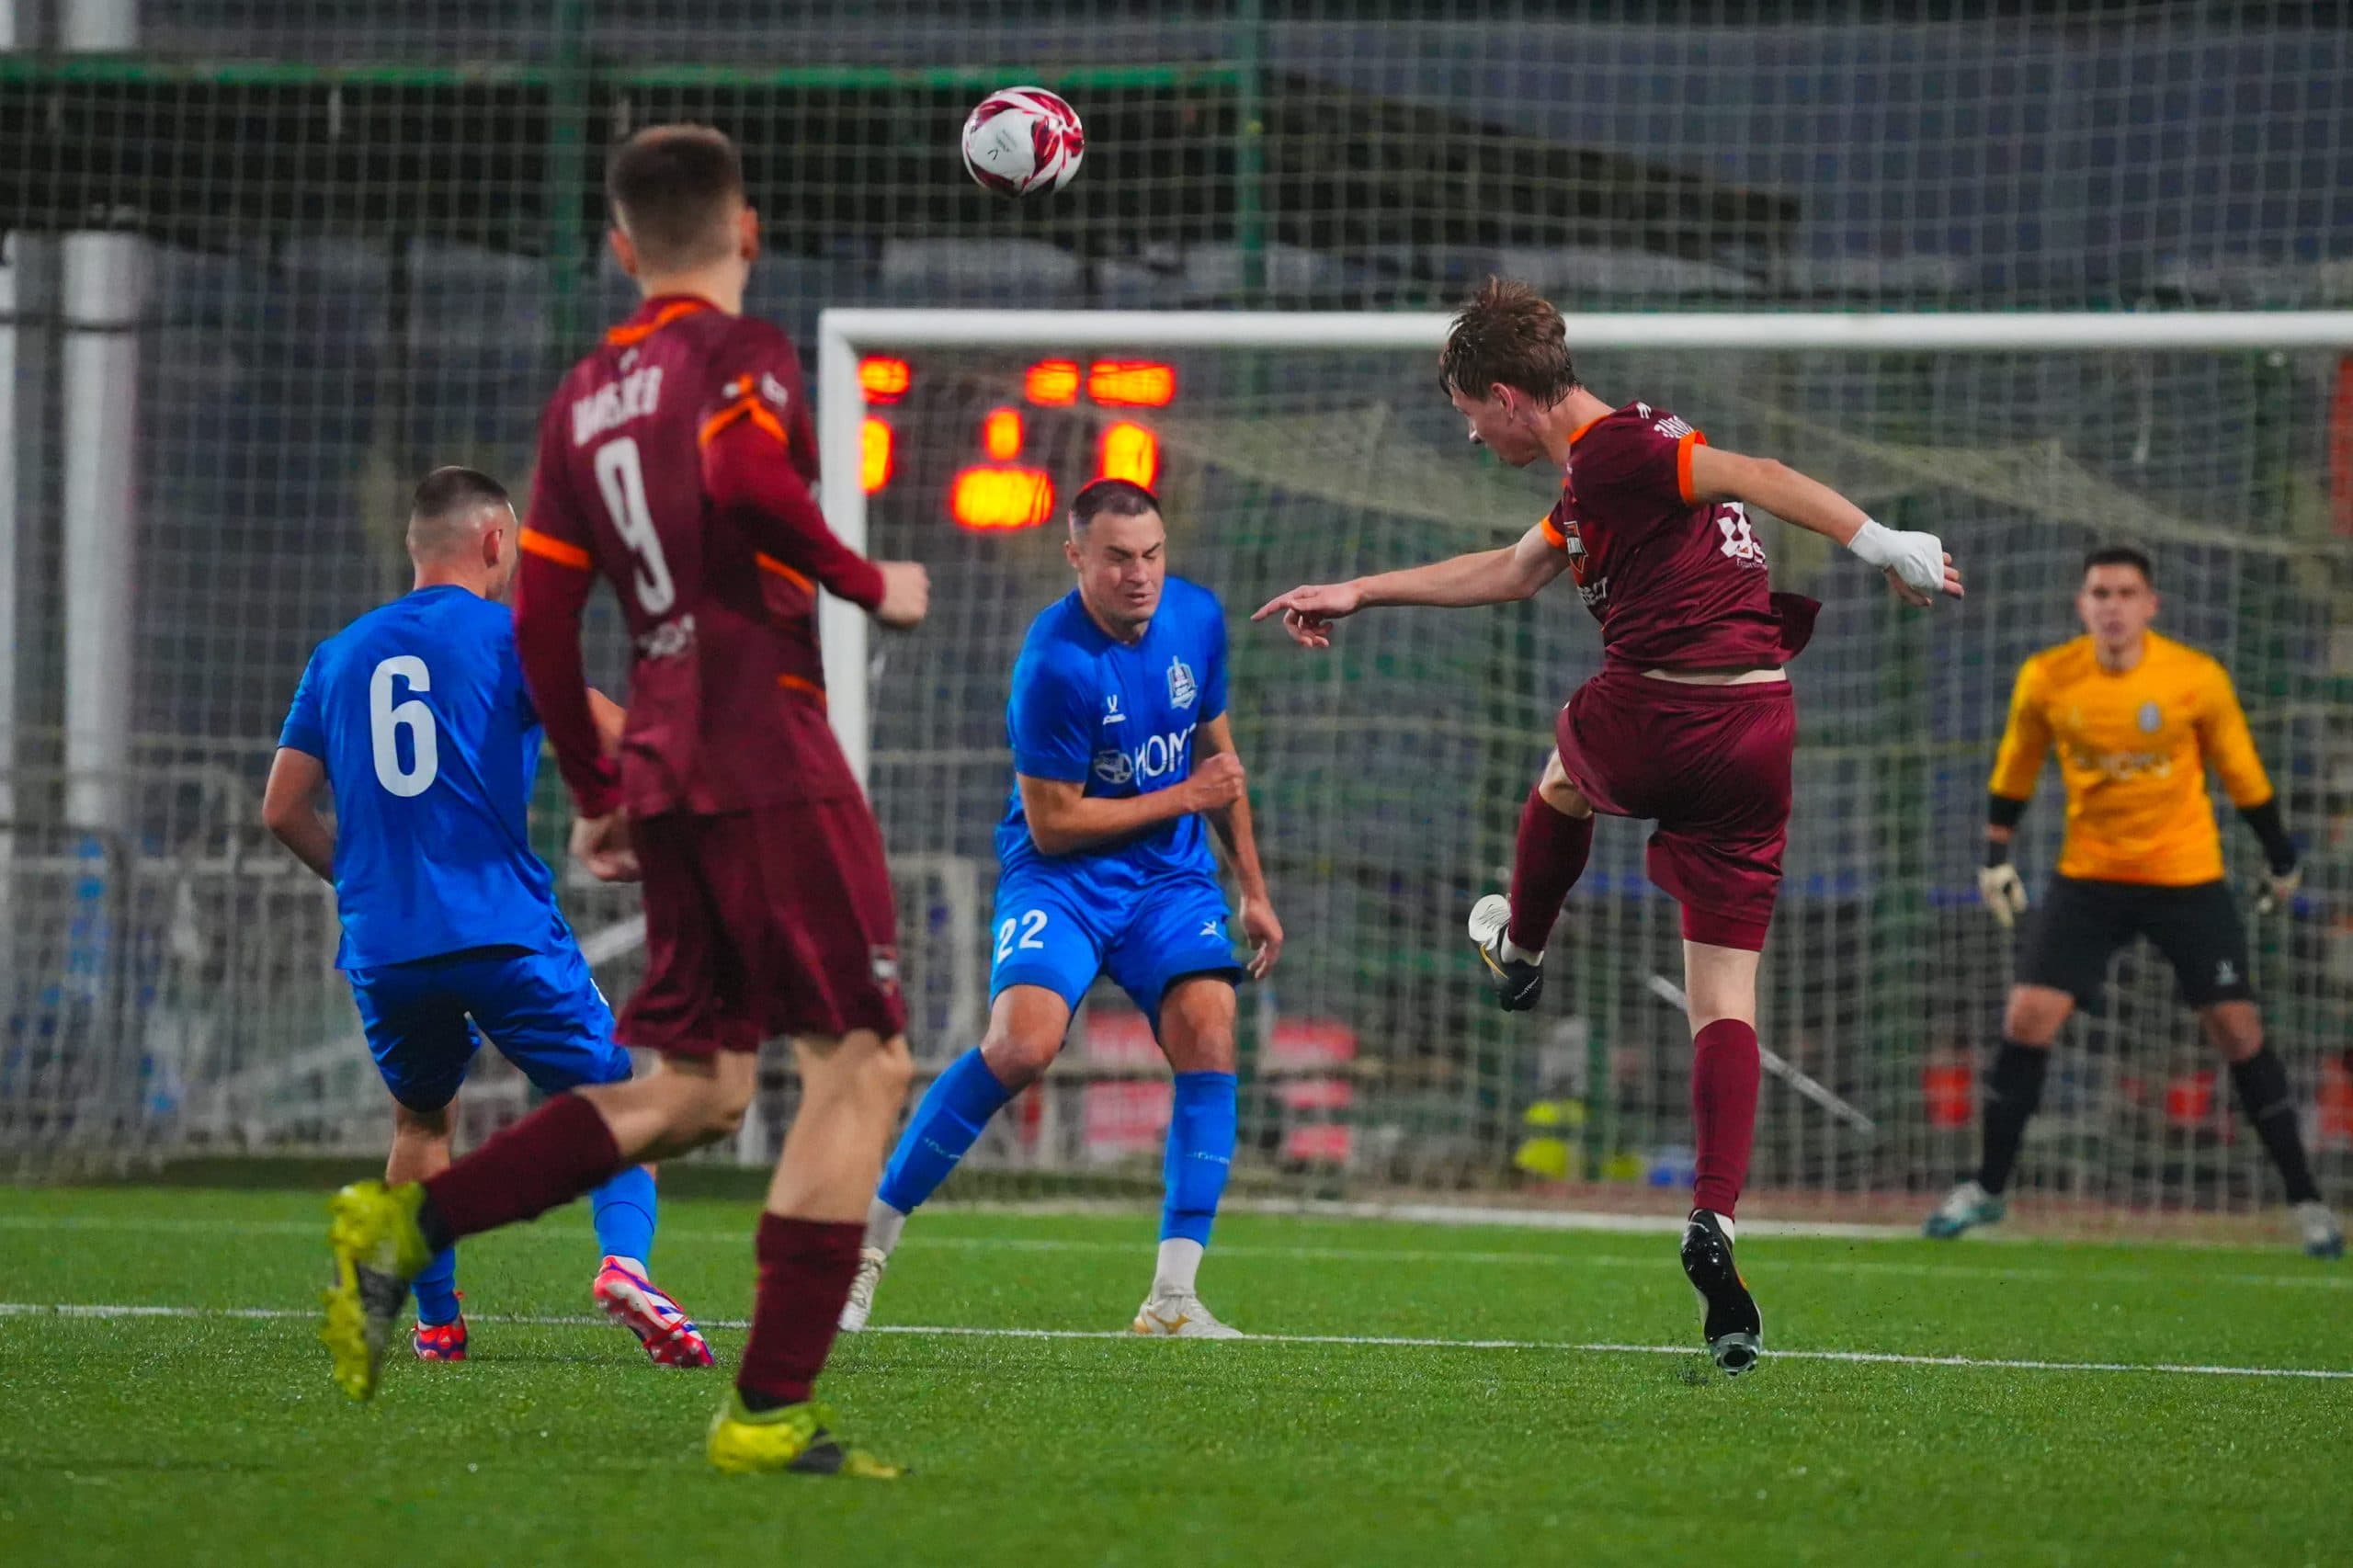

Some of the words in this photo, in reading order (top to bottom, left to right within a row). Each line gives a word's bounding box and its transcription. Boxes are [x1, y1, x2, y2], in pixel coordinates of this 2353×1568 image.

[594, 437, 676, 615] 9
[370, 655, 438, 797] 6
[996, 909, 1049, 963] 22
